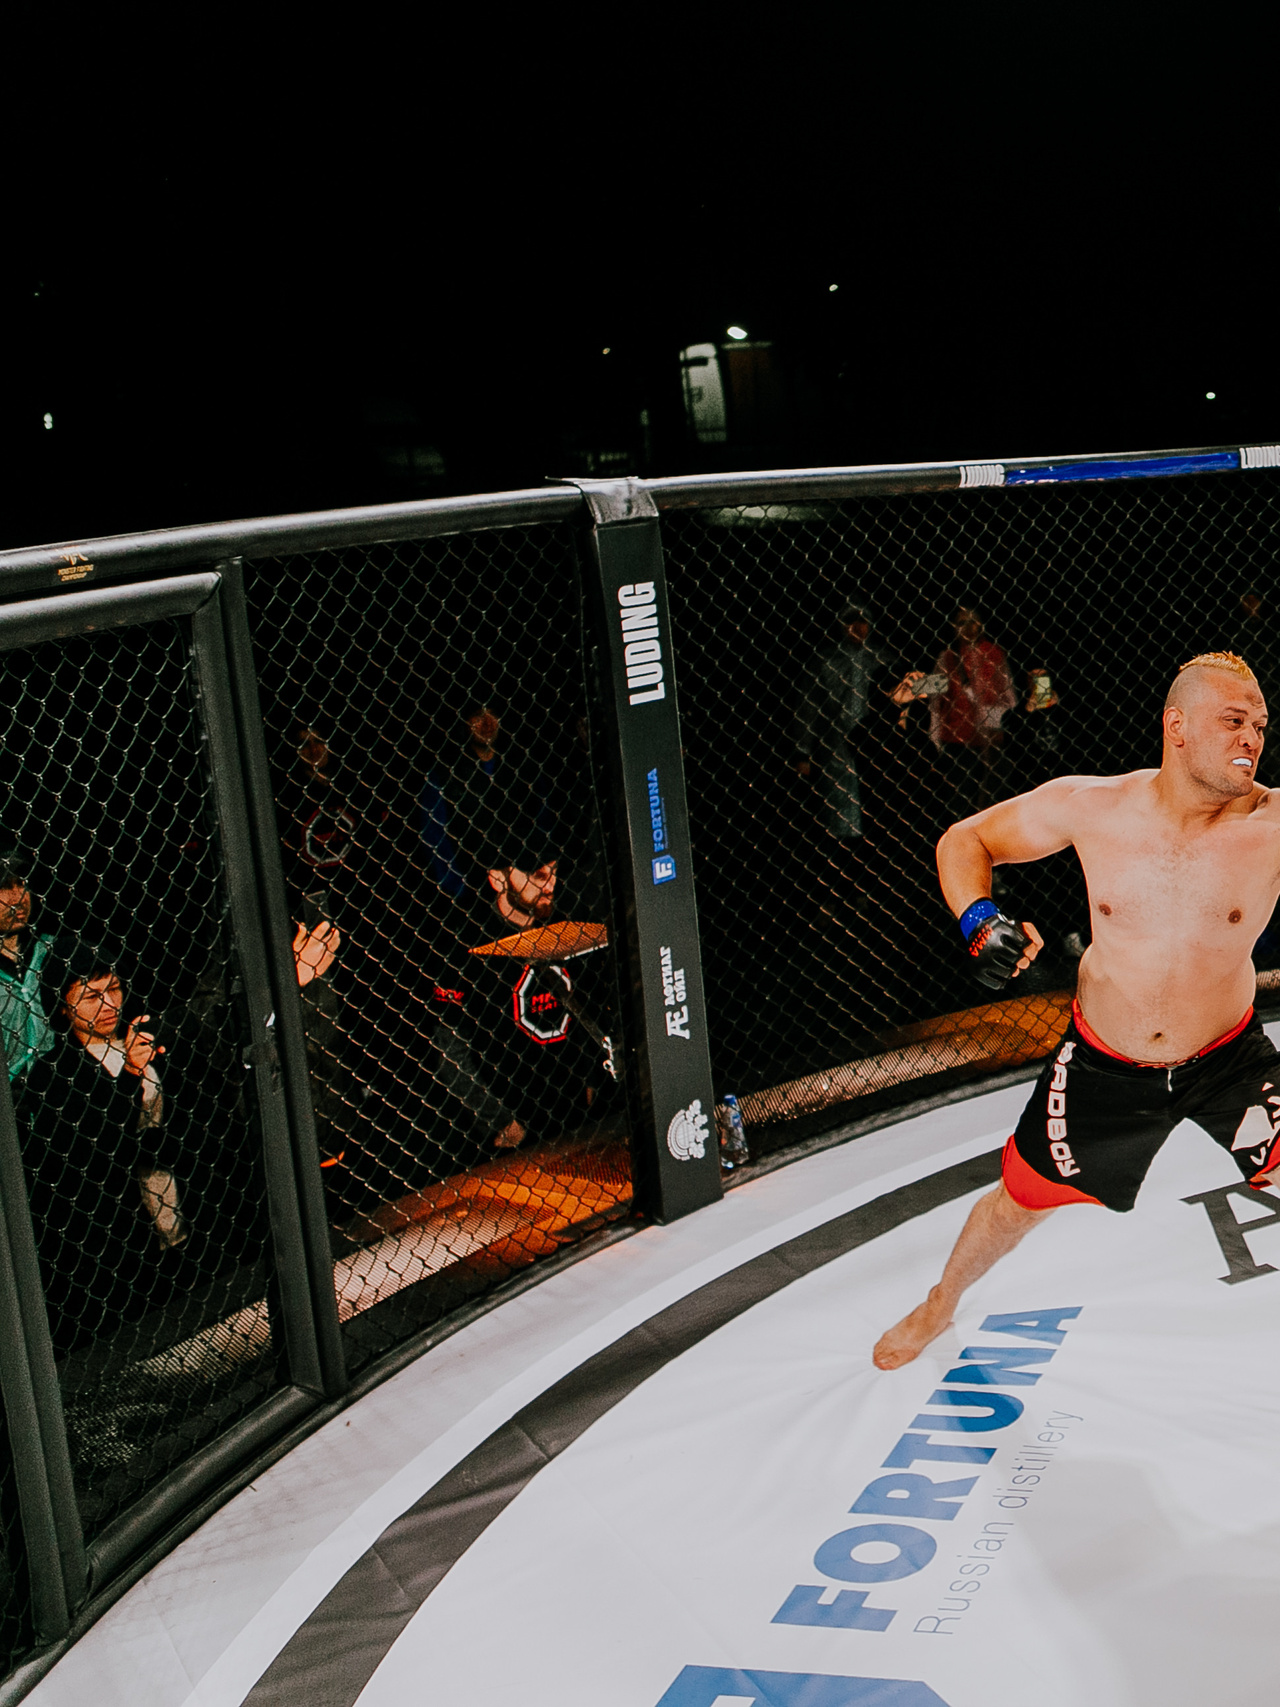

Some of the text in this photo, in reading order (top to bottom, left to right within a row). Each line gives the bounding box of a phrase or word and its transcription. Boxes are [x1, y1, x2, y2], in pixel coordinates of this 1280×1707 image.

[959, 464, 1005, 488] LUDING
[618, 581, 666, 706] LUDING
[647, 767, 665, 852] FORTUNA
[770, 1306, 1084, 1632] FORTUNA
[912, 1409, 1084, 1635] Russian distillery
